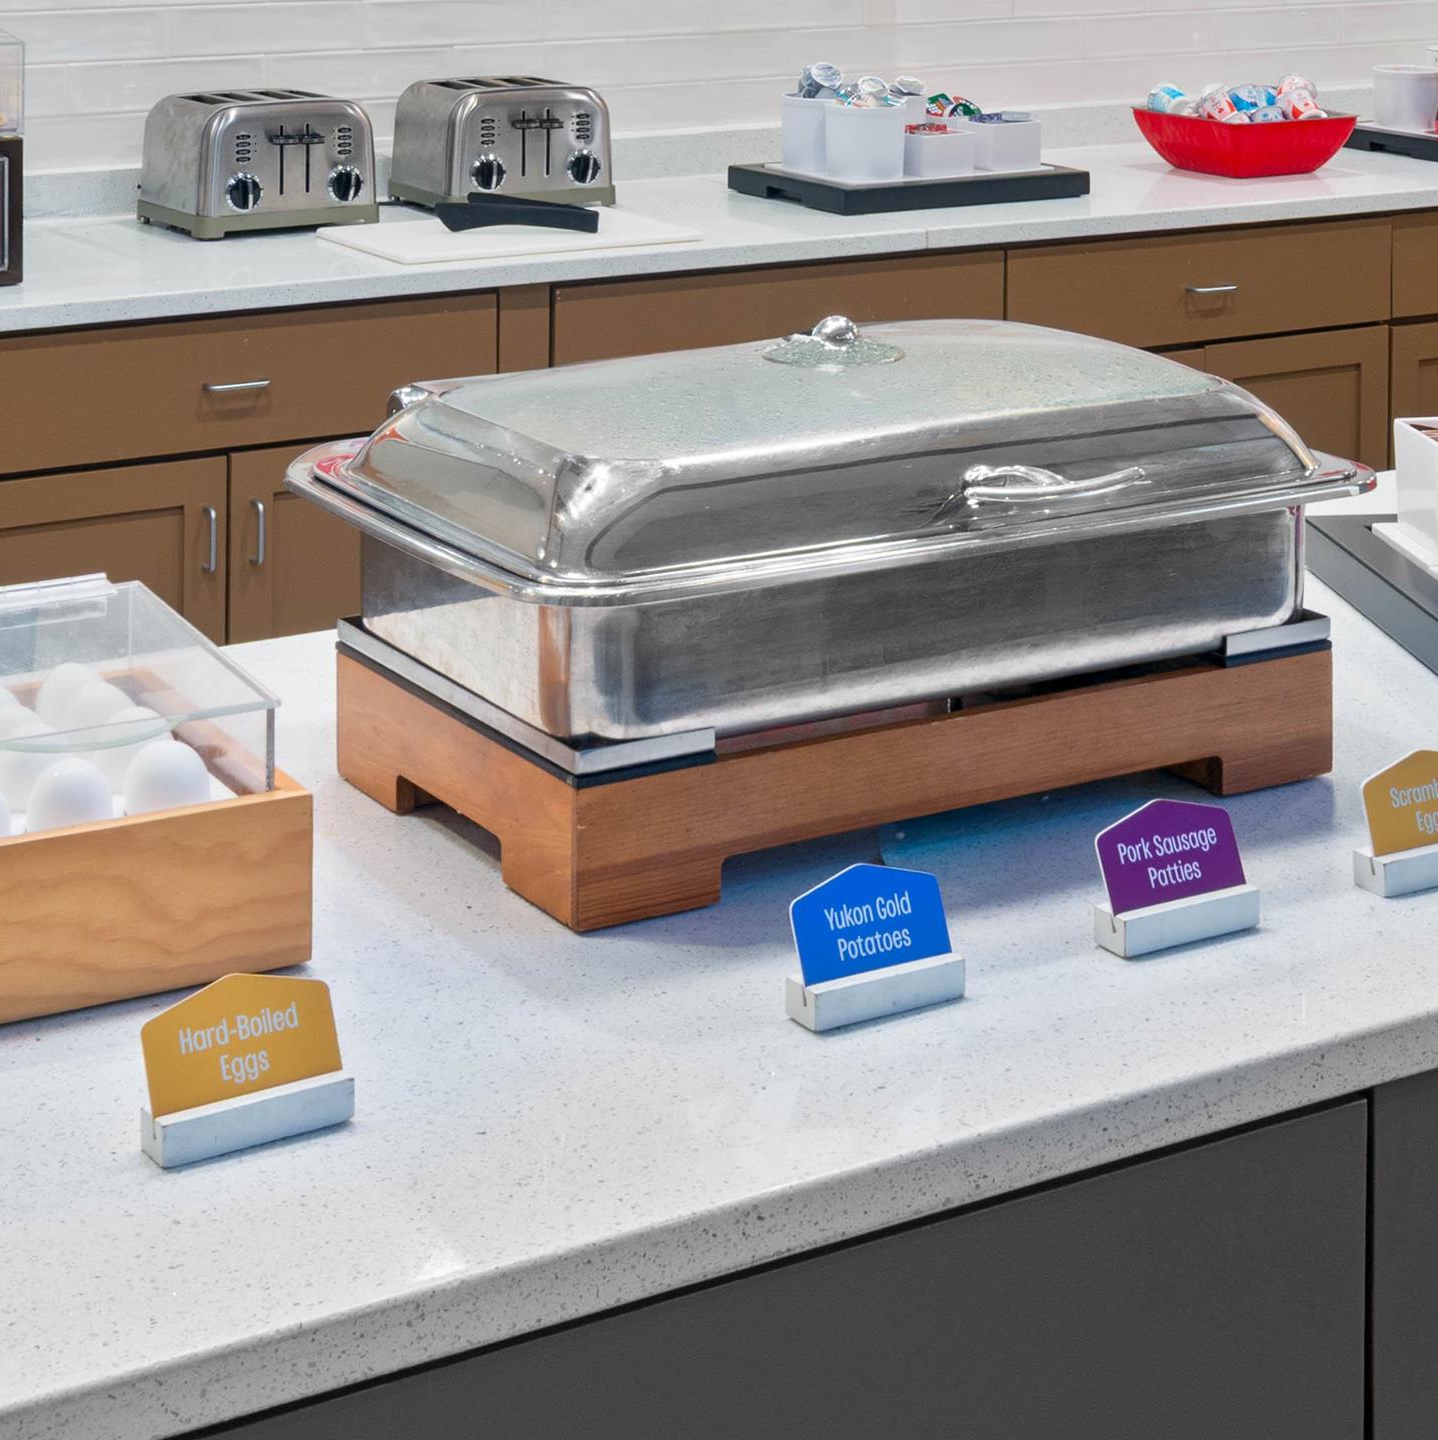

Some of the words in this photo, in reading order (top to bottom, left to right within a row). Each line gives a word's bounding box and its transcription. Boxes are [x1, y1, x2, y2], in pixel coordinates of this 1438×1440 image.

[1117, 837, 1153, 865] Pork
[1153, 827, 1217, 856] Sausage
[1147, 860, 1202, 889] Patties
[824, 904, 874, 931] Yukon
[875, 890, 912, 920] Gold
[837, 928, 911, 961] Potatoes
[178, 1001, 299, 1055] Hard-Boiled
[219, 1050, 270, 1085] Eggs
